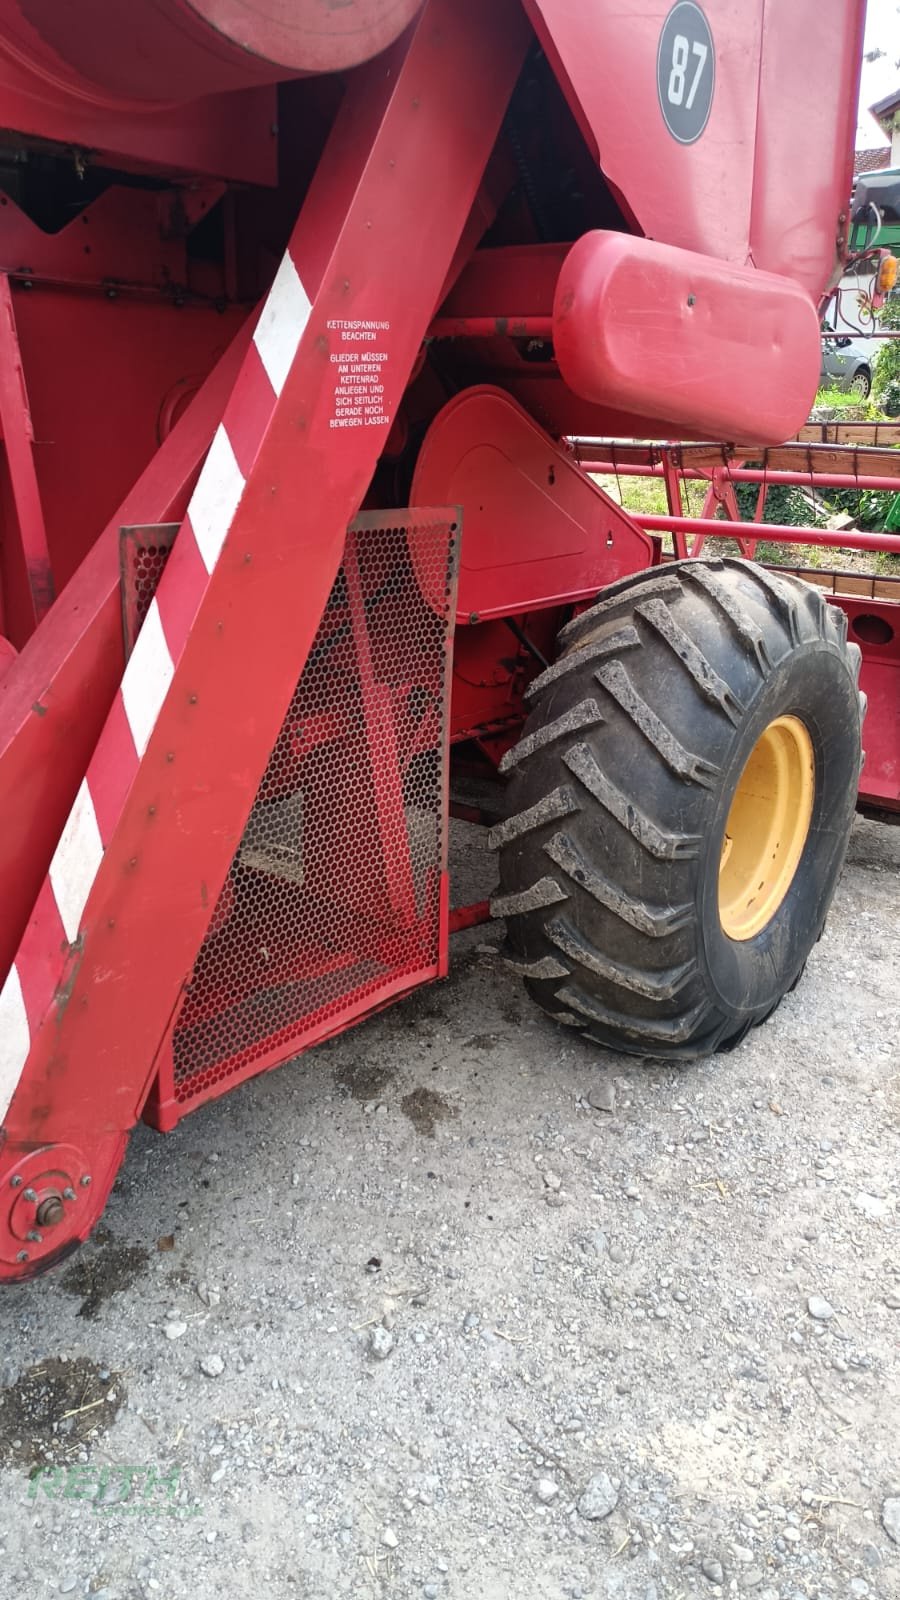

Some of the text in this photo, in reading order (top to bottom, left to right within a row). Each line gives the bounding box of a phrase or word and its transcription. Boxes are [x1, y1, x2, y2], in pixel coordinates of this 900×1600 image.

[668, 34, 708, 110] 87
[327, 320, 390, 330] KETTENSPANNUNG
[342, 332, 376, 341] BEACHTEN
[330, 352, 388, 363] GLIEDER MÜSSEN
[338, 364, 381, 373] AM UNTEREN
[340, 375, 379, 384] KETTENRAD
[334, 385, 384, 395] ANLIEGEN UND
[335, 396, 383, 406] SICH SEITLICH
[335, 406, 383, 417] GERADE NOCH
[329, 416, 389, 428] BEWEGEN LASSEN
